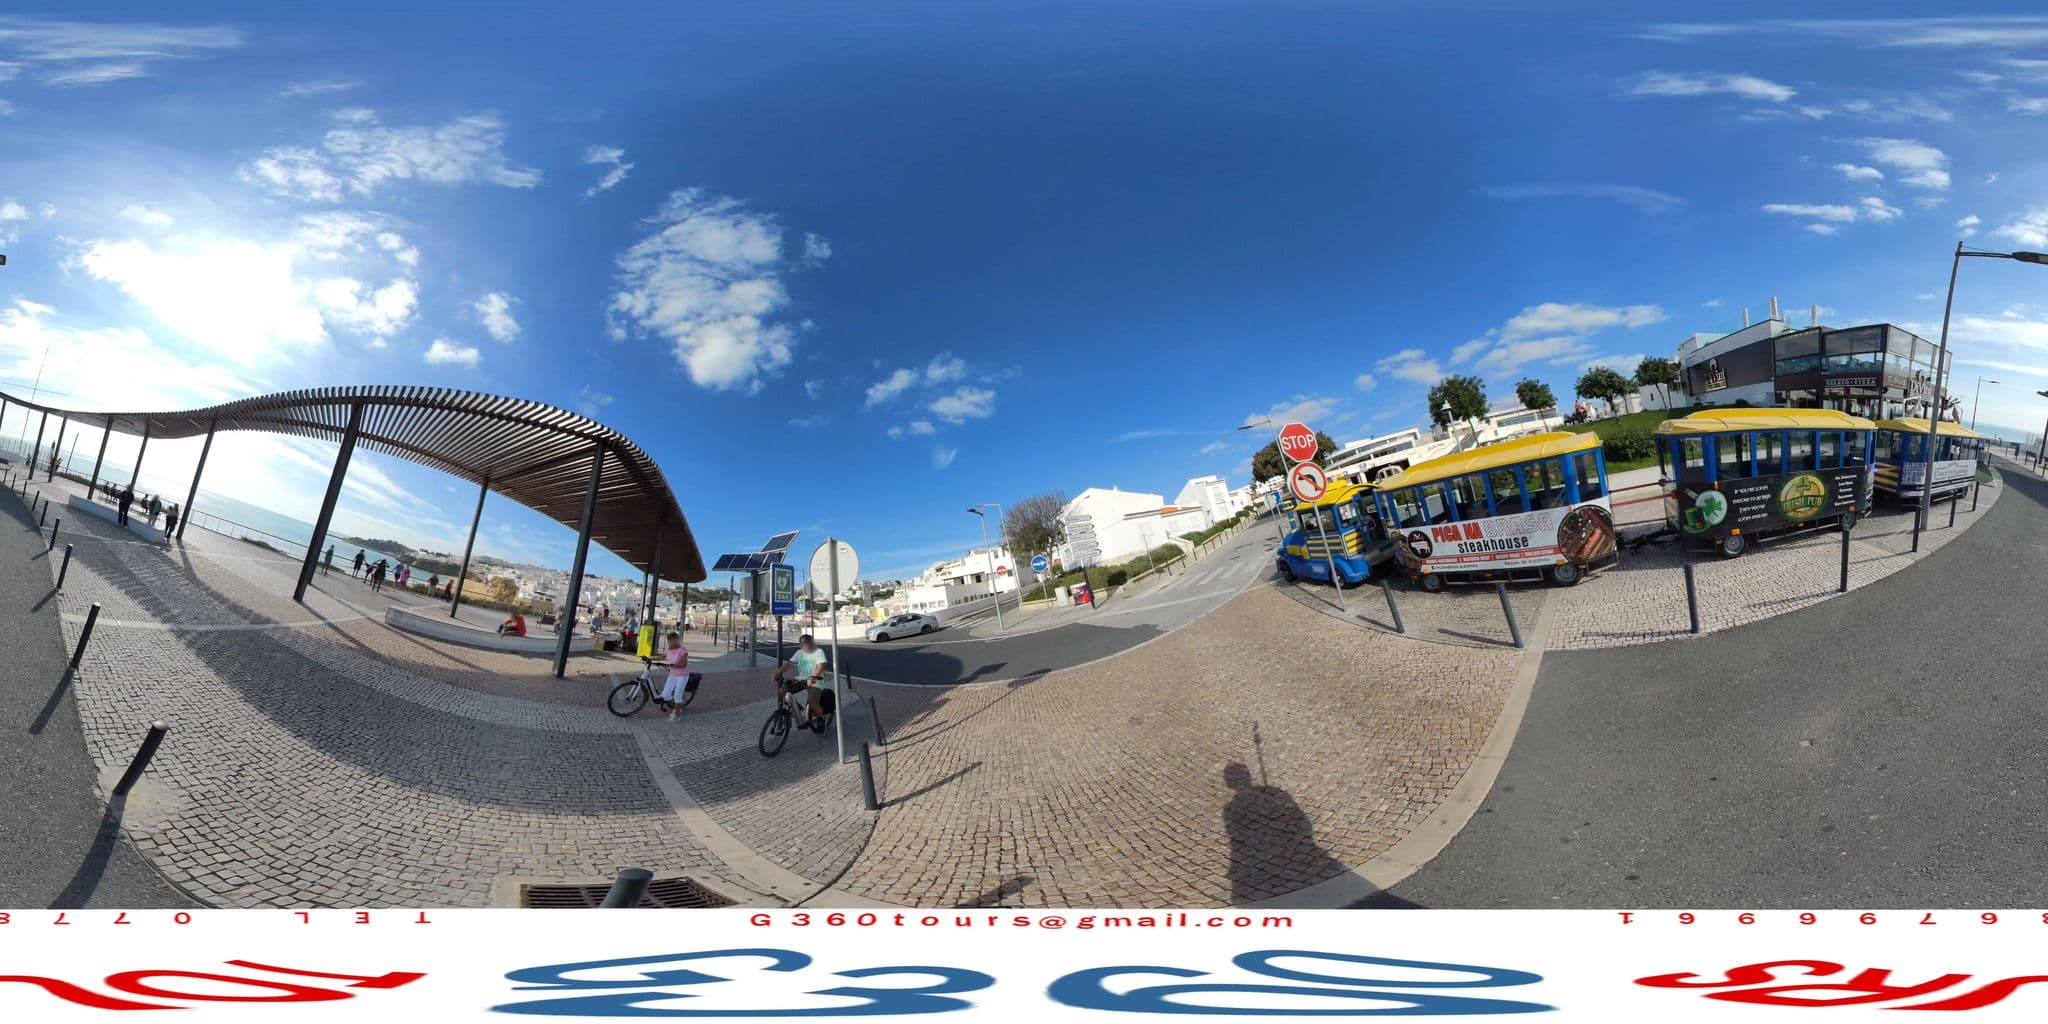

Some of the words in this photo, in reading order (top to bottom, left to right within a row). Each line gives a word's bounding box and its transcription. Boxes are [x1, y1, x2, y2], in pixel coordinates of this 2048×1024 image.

[1854, 378, 1876, 386] PIZZA
[1281, 434, 1314, 450] STOP
[1782, 497, 1805, 513] IRISH
[1807, 496, 1823, 507] PUB
[1464, 522, 1483, 540] NA
[1457, 536, 1529, 554] steakhouse
